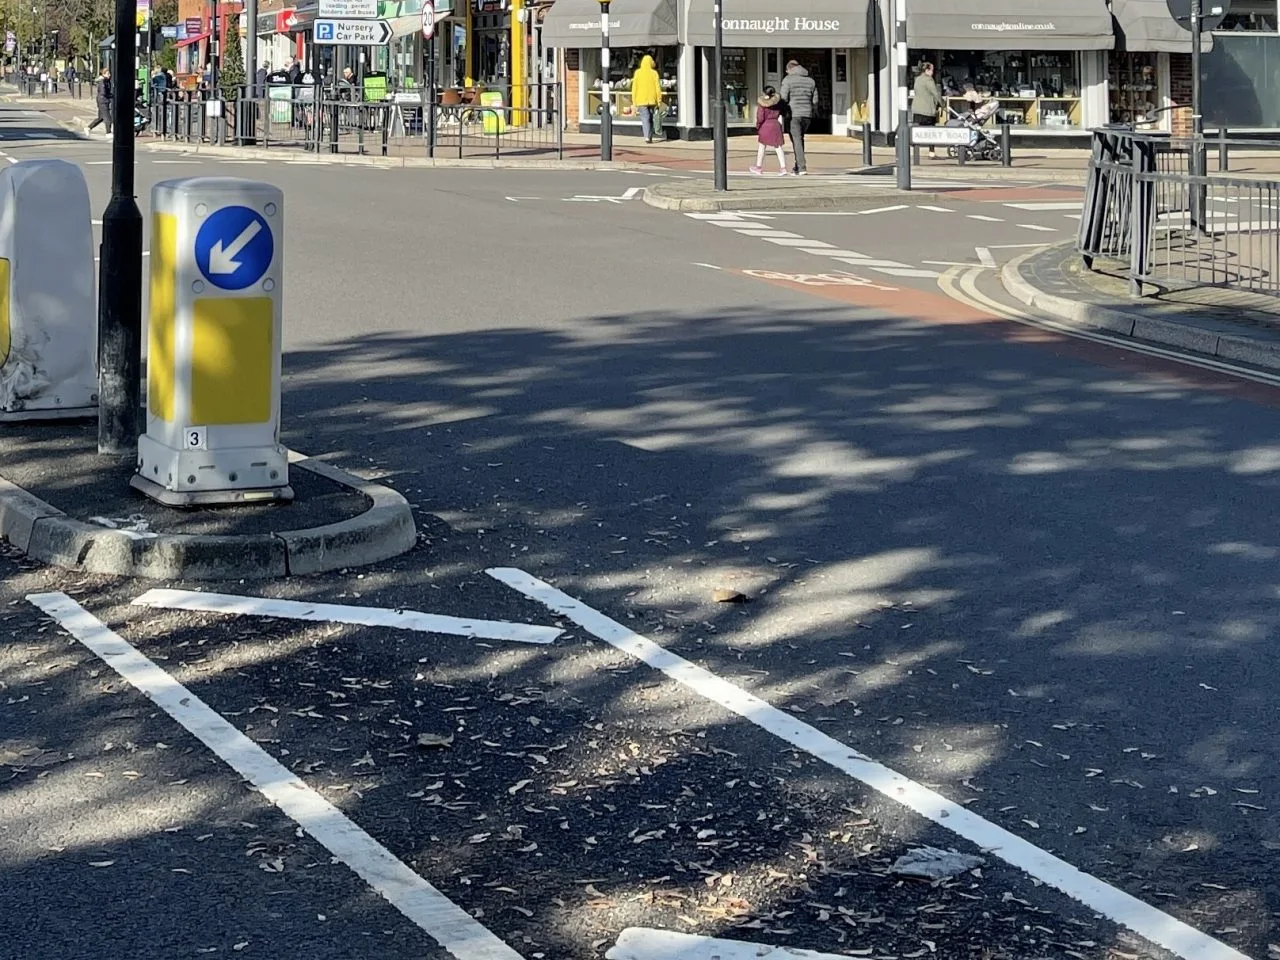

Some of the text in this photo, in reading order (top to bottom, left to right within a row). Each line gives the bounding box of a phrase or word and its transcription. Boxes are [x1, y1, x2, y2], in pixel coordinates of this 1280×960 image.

[423, 11, 433, 27] 20
[794, 17, 840, 31] House
[319, 24, 330, 39] P
[337, 22, 373, 32] Nursery
[914, 131, 943, 139] ALBERT
[190, 431, 199, 446] 3
